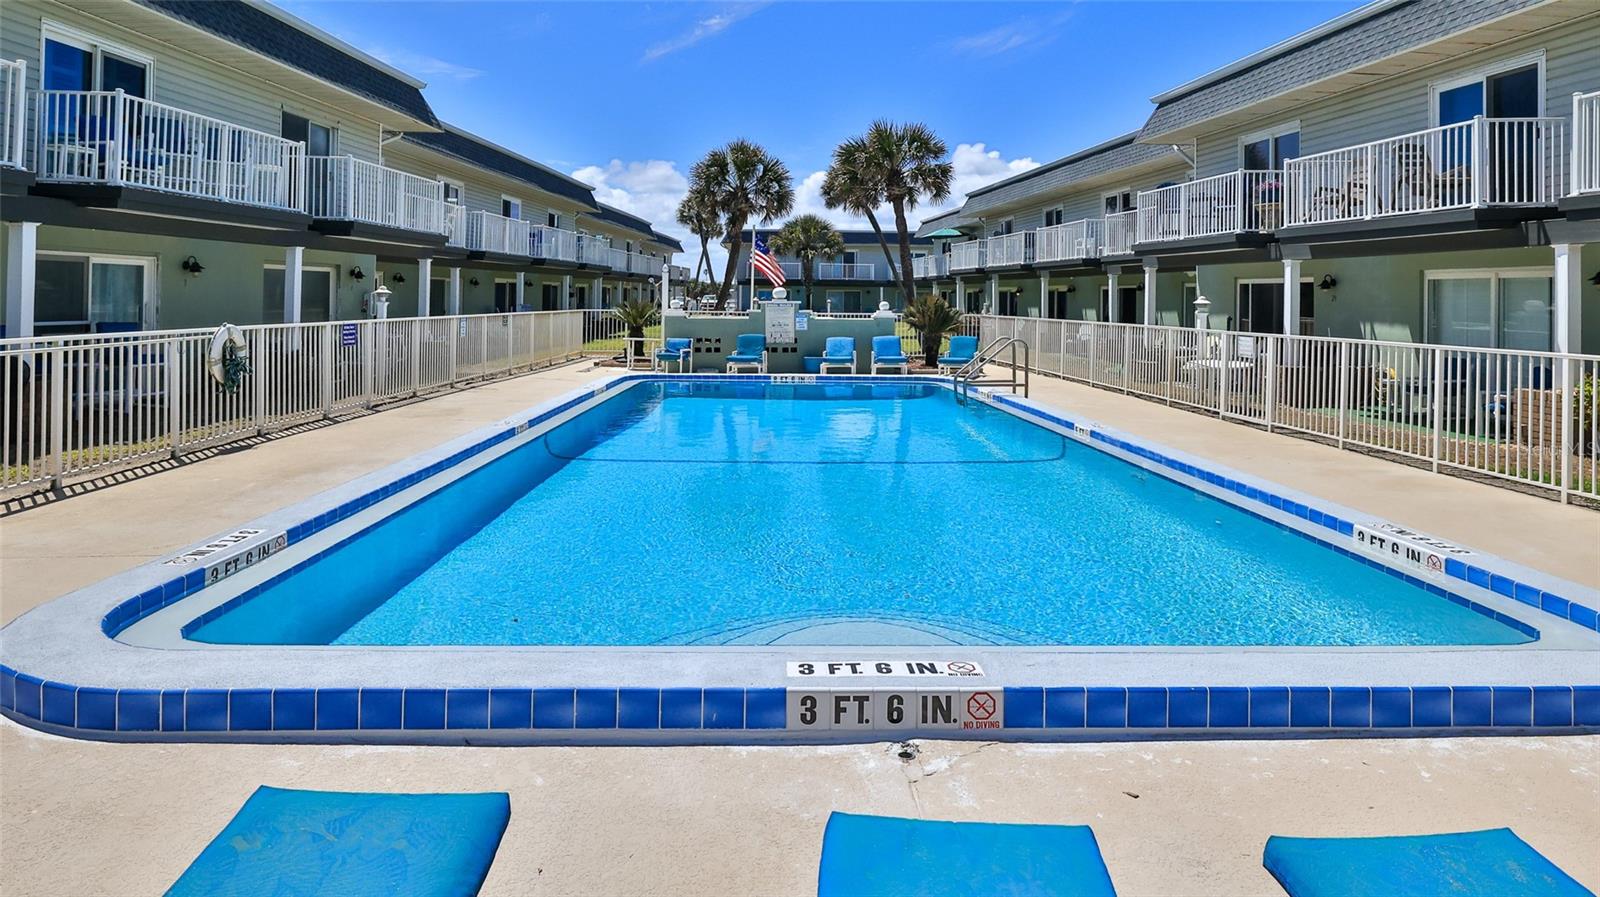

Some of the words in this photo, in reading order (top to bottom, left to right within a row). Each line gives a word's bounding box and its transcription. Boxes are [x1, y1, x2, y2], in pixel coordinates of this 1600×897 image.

[224, 558, 240, 576] FT
[797, 662, 815, 675] 3
[827, 662, 863, 675] FT.
[875, 662, 893, 675] 6
[905, 662, 944, 675] IN.
[799, 695, 818, 725] 3
[833, 695, 870, 725] FT.
[886, 694, 904, 725] 6
[921, 695, 958, 725] IN.
[963, 720, 974, 730] NO
[975, 720, 1000, 730] DIVING
